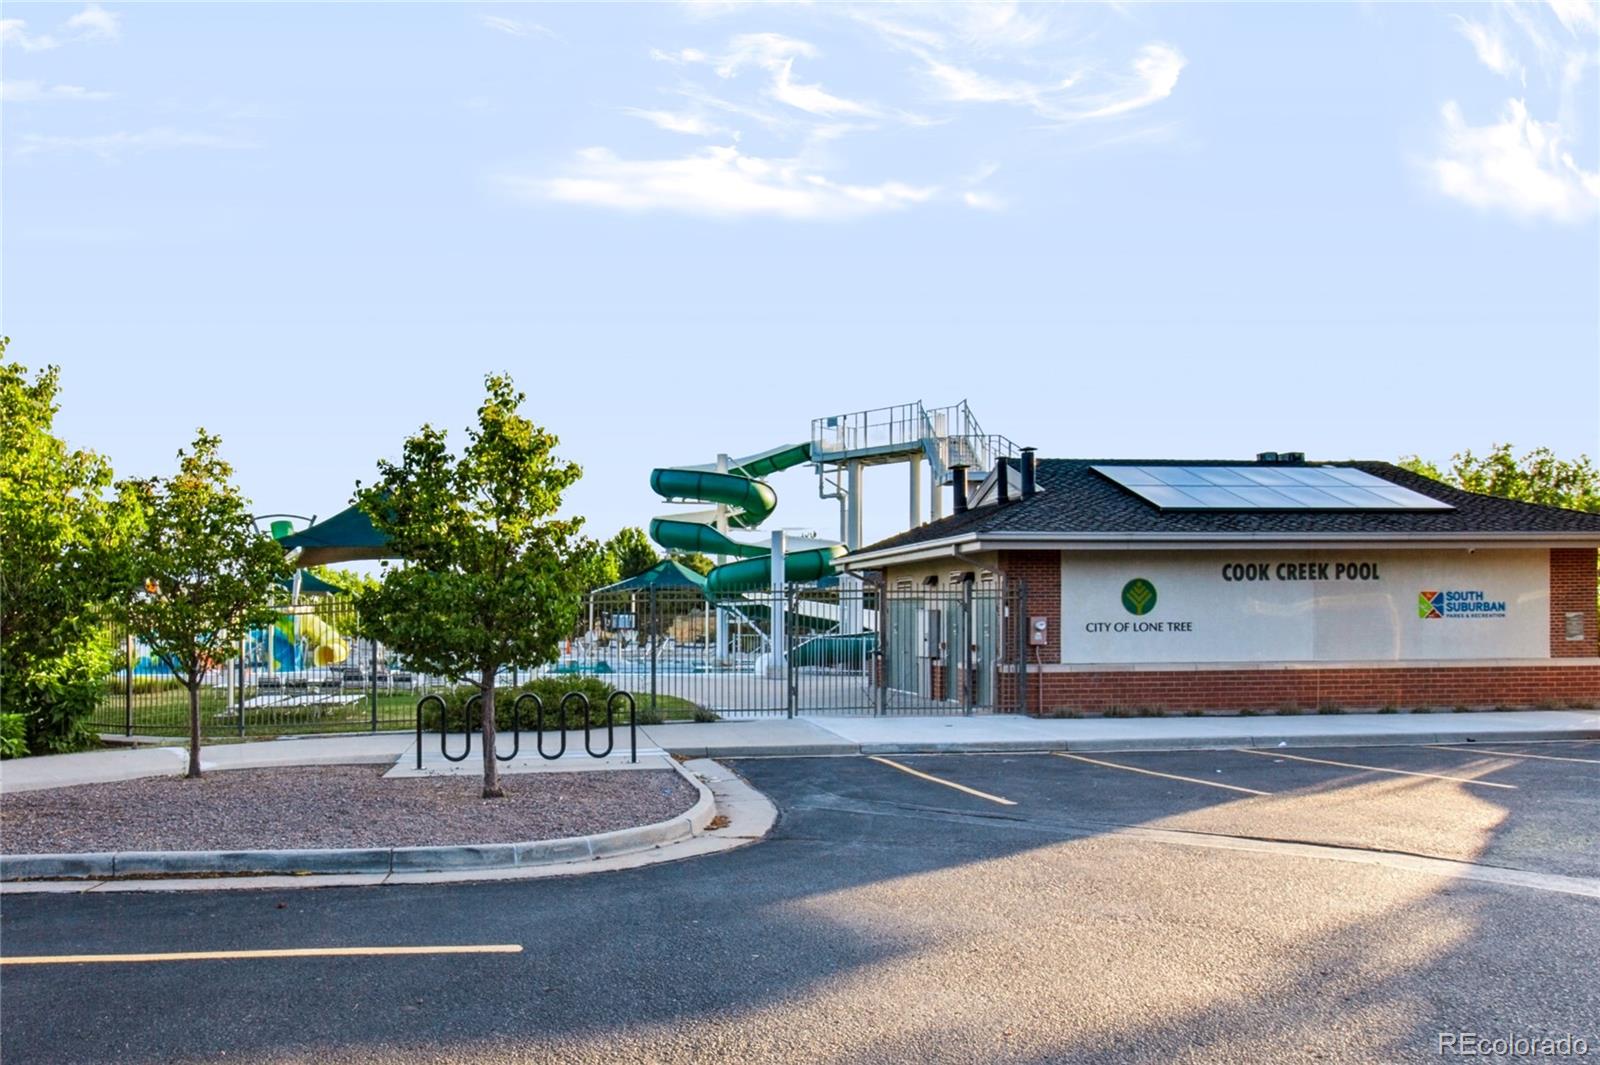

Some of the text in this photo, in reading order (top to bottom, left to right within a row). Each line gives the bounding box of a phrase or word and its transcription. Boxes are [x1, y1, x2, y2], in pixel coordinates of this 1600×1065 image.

[1222, 562, 1380, 581] COOK CREEK POOL
[1446, 591, 1483, 601] SOUTH
[1446, 602, 1506, 612] SUBURBAN
[1085, 621, 1193, 632] CITY OF LONE TREE
